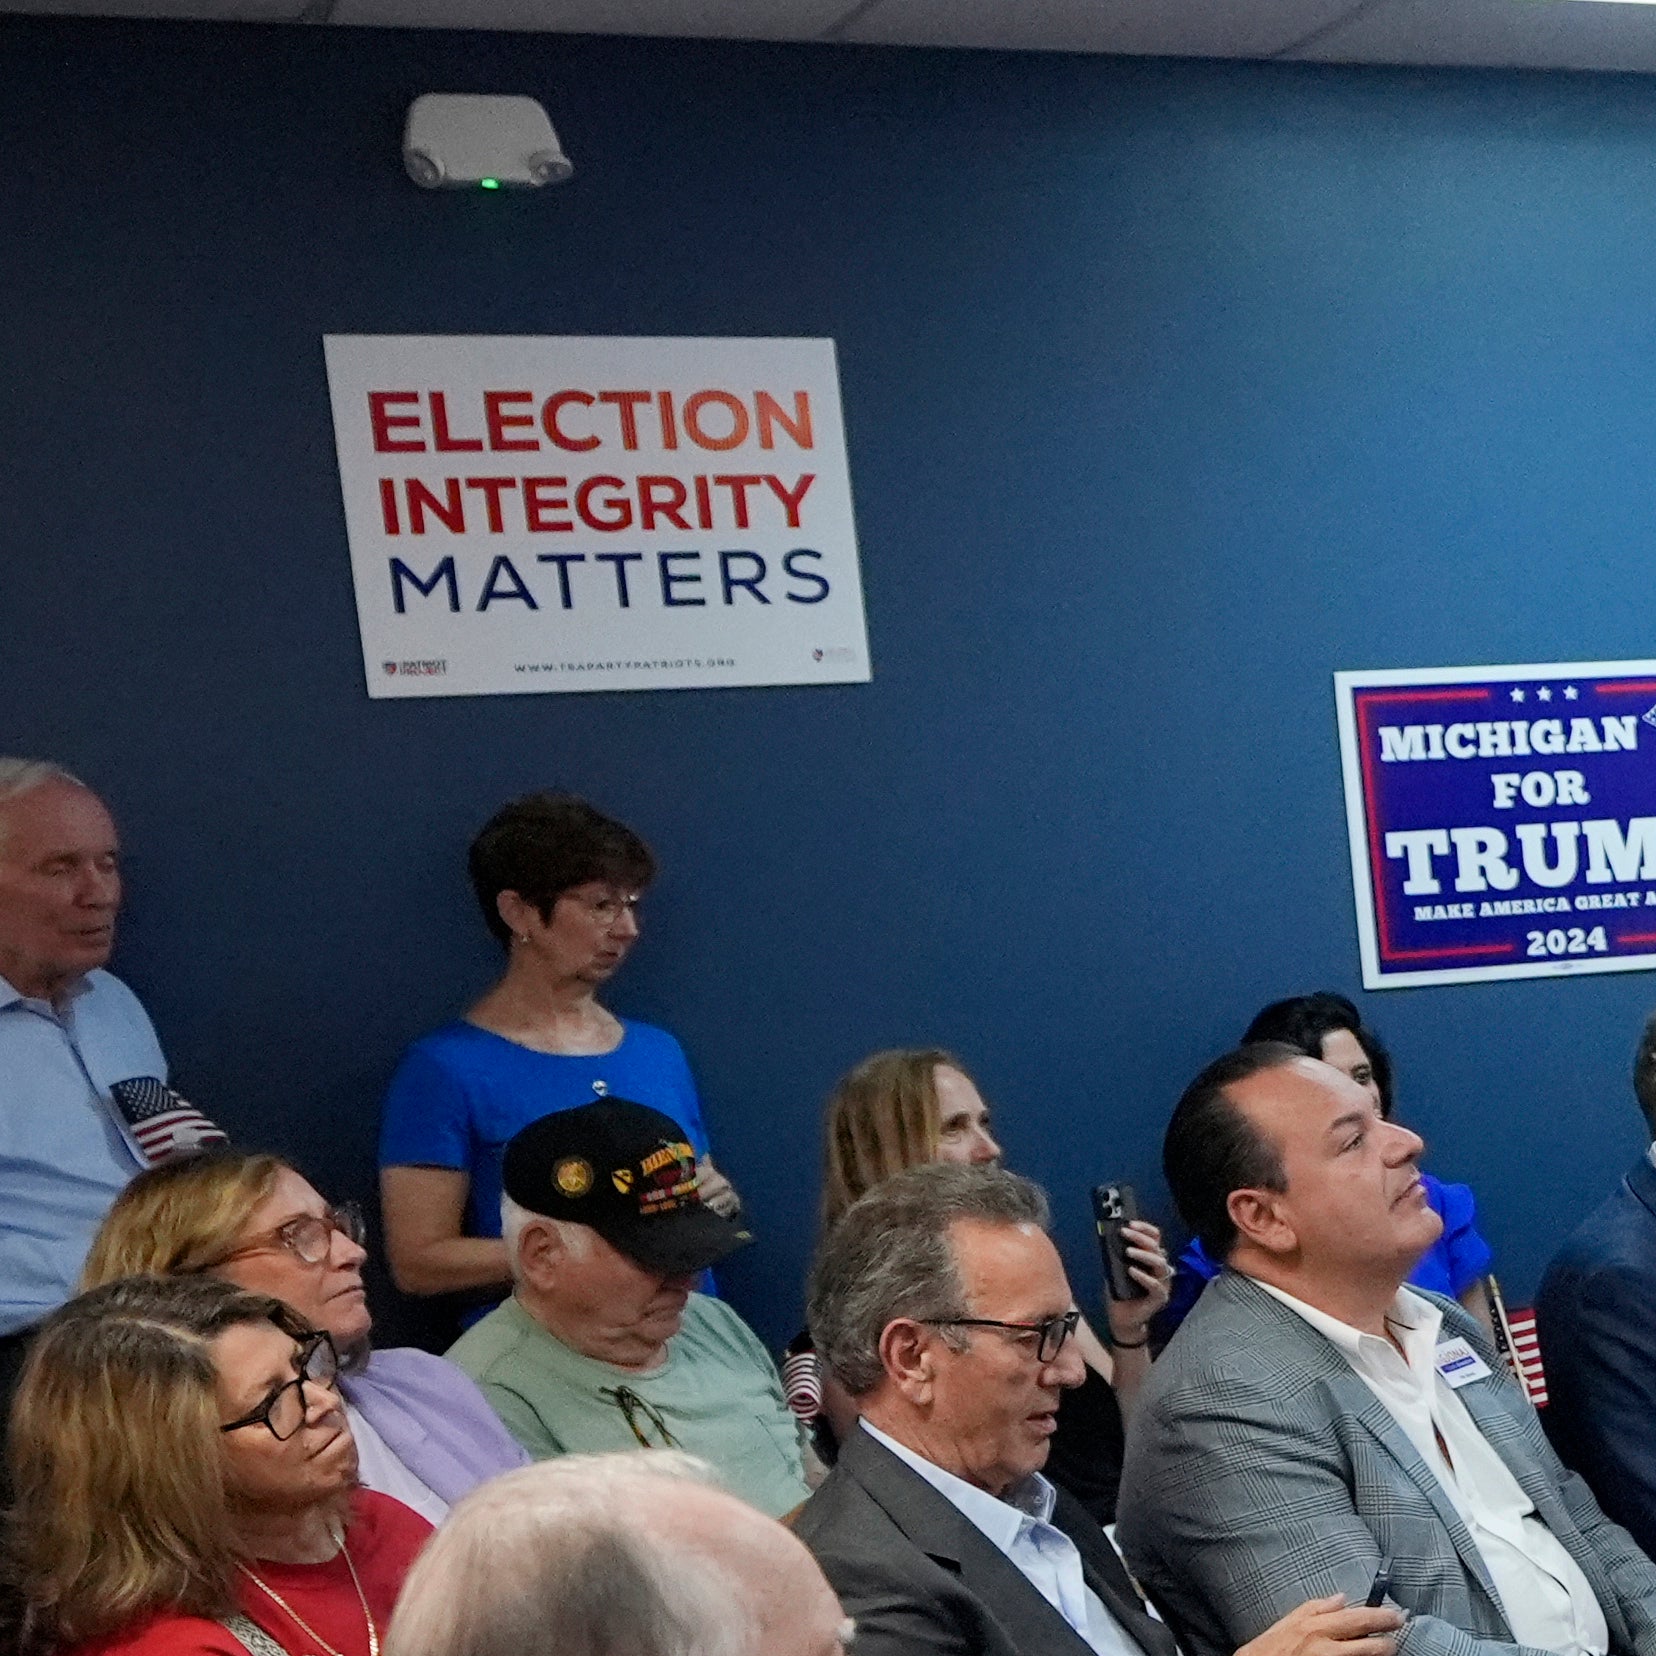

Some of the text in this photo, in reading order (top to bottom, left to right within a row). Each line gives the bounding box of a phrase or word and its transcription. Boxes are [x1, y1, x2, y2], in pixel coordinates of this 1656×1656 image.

[367, 389, 816, 453] ELECTION
[378, 473, 817, 536] INTEGRITY
[388, 548, 831, 614] MATTERS
[1378, 715, 1638, 762] MICHIGAN
[1490, 770, 1591, 809] FOR
[1413, 904, 1475, 921] MAKE
[1478, 897, 1572, 917] AMERICA
[1574, 891, 1641, 911] GREAT
[1526, 926, 1608, 957] 2024
